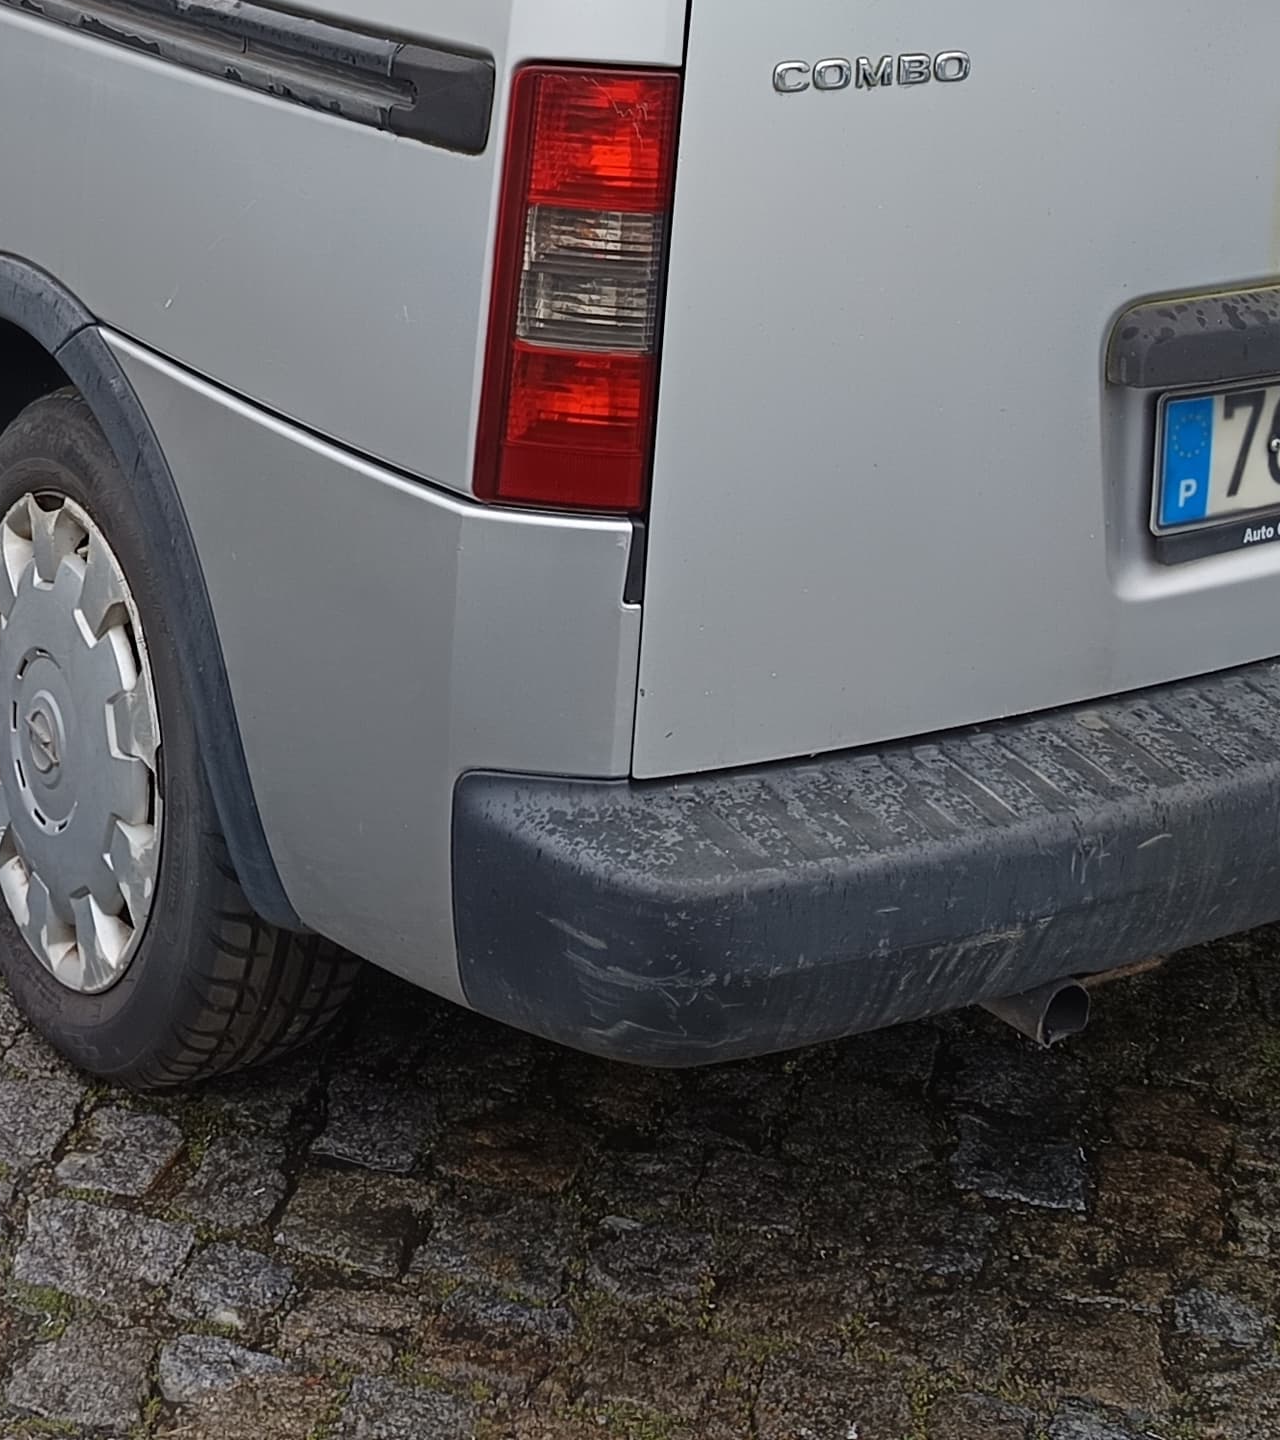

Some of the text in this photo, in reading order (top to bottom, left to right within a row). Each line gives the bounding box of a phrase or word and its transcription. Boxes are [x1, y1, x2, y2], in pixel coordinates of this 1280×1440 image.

[772, 49, 972, 94] COMBO
[1178, 479, 1197, 509] P
[1243, 527, 1274, 543] Auto
